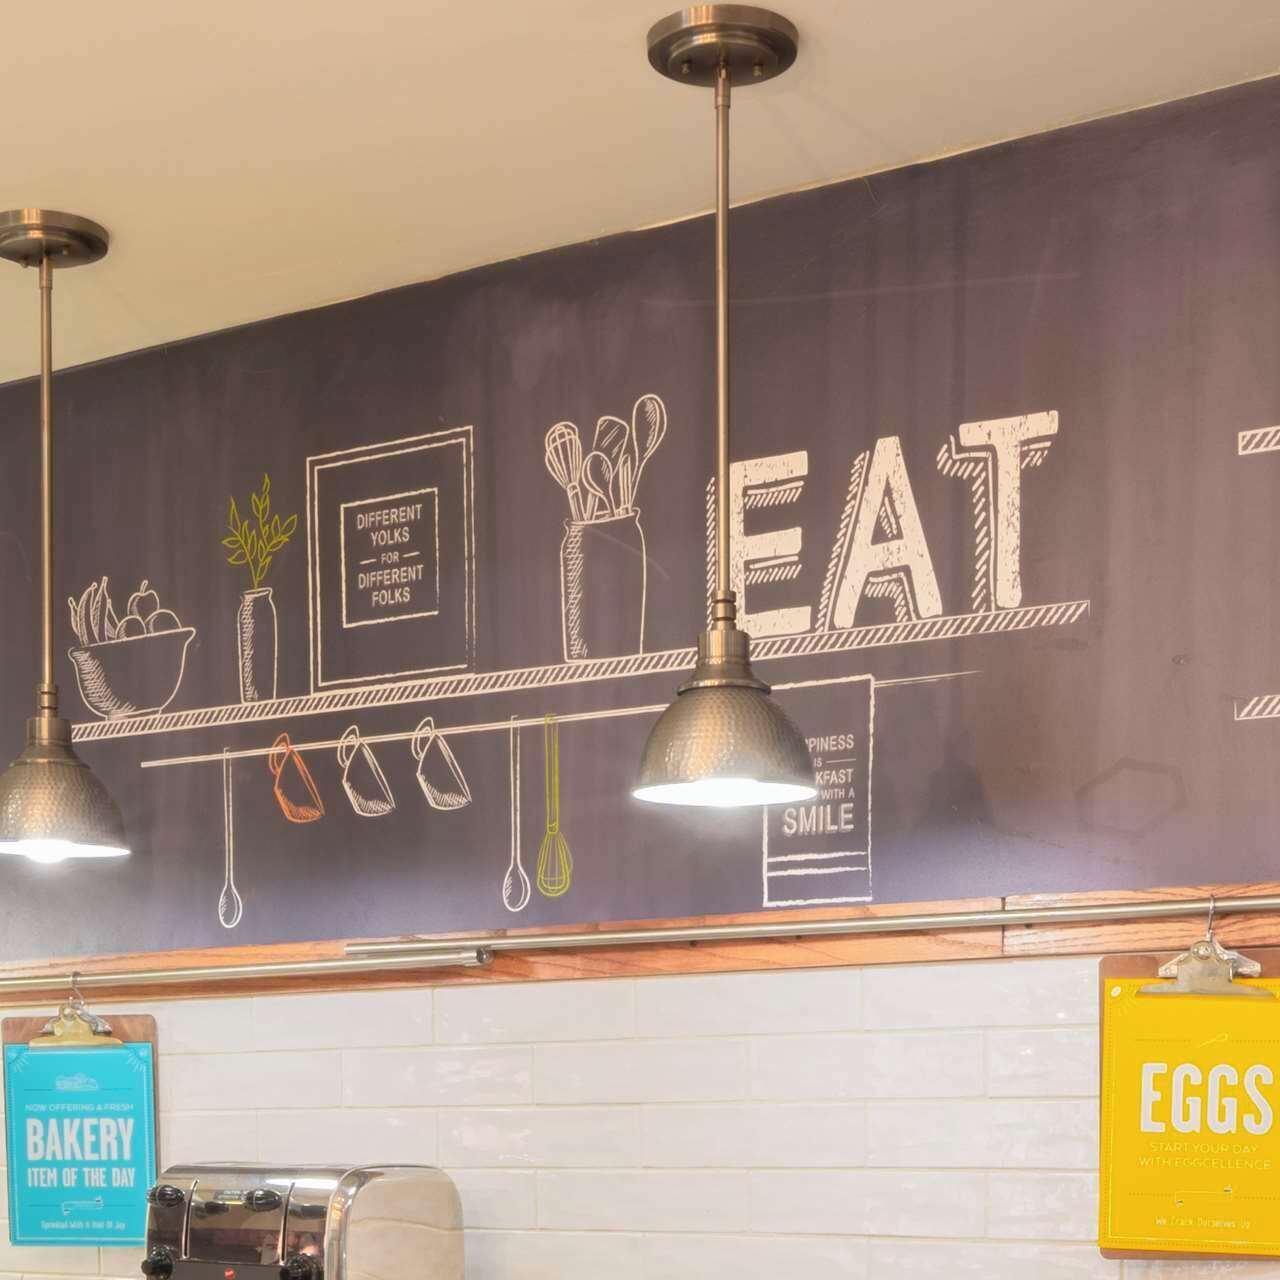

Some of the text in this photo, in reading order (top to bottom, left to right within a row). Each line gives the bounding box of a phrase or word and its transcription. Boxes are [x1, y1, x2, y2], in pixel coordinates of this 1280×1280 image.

[356, 504, 423, 530] DIFFERENT
[718, 409, 1059, 639] EAT
[370, 526, 410, 547] YOLKS
[380, 551, 400, 565] FOR
[358, 564, 424, 590] DIFFERENT
[371, 586, 411, 608] FOLKS
[804, 733, 855, 753] PINESS
[815, 768, 855, 786] KFAST
[821, 786, 856, 800] WITH A
[783, 802, 855, 835] SMILE
[1140, 1062, 1274, 1136] EGGS
[25, 1117, 135, 1162] BAKERY
[1149, 1141, 1259, 1155] START YOUR DAY
[1139, 1156, 1273, 1171] WITH EGGCELLENCE
[27, 1167, 136, 1189] ITEM OF THE DAY
